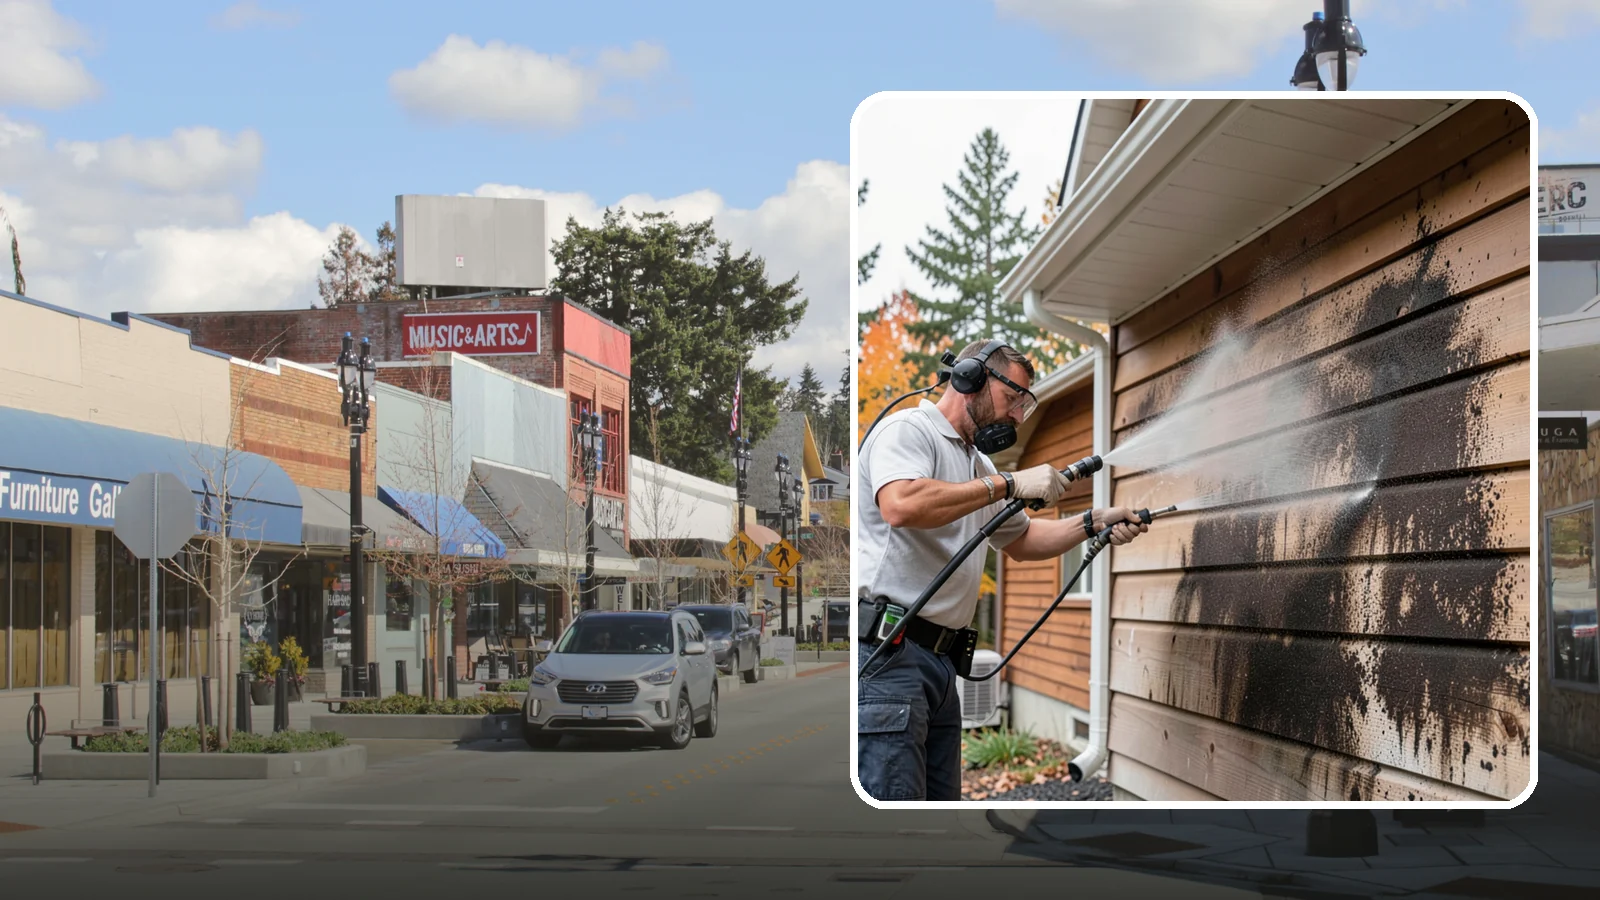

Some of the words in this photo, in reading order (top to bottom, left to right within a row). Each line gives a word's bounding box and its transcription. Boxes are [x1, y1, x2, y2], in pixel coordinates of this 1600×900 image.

[408, 322, 520, 349] MUSIC&ARTS
[1540, 427, 1577, 437] UGA
[0, 471, 79, 515] Furniture
[453, 563, 479, 574] SUSHI
